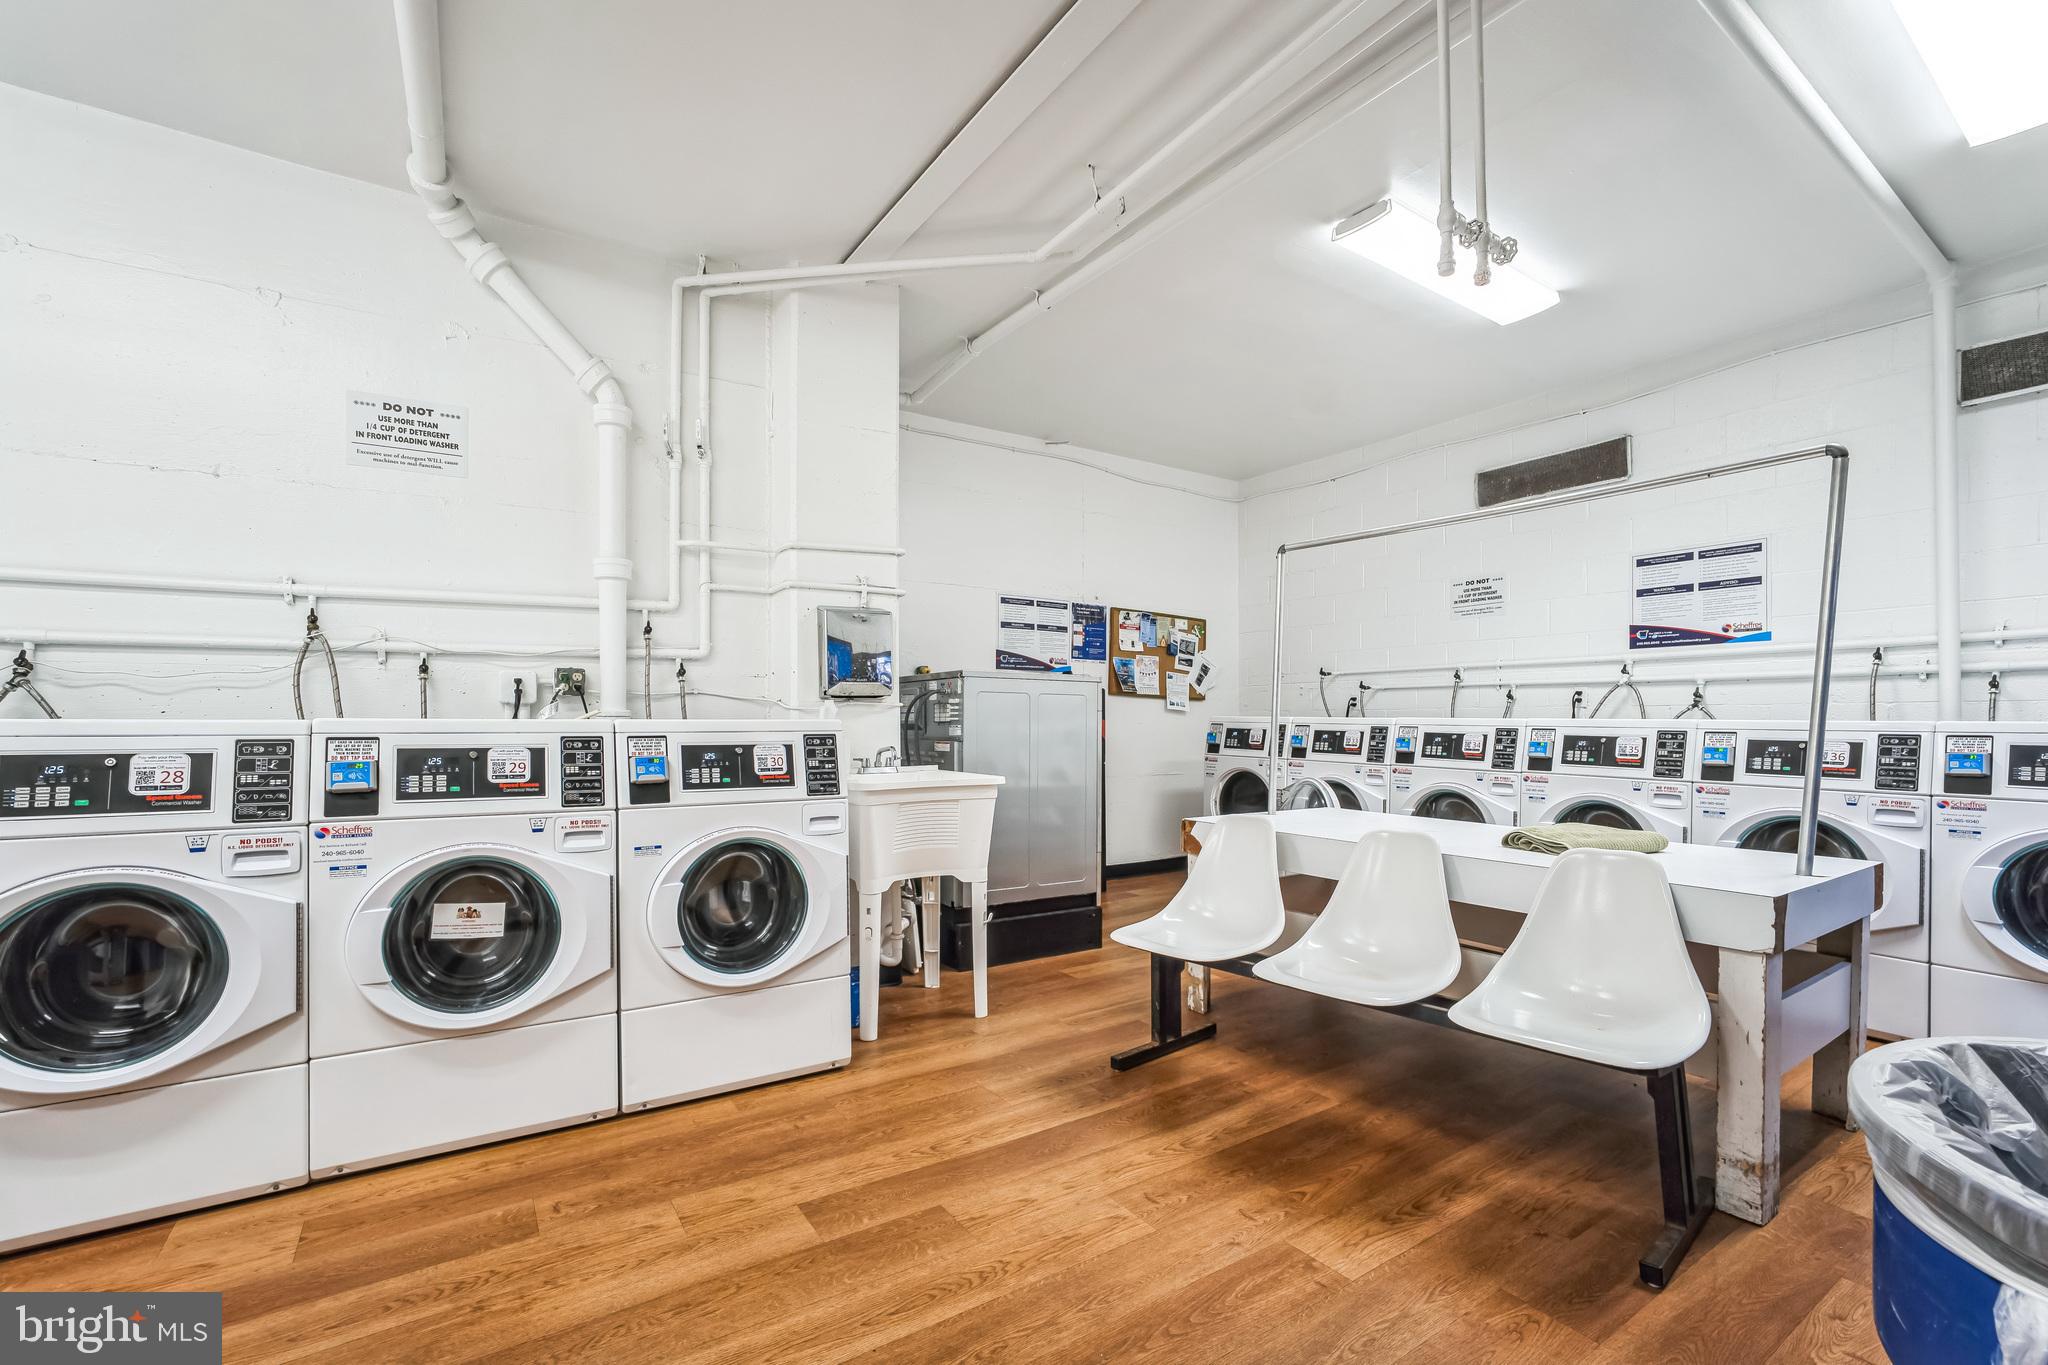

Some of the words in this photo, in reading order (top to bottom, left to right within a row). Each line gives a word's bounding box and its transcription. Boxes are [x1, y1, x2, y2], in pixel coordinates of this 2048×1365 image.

[383, 402, 402, 412] DO
[406, 406, 434, 417] NOT
[378, 415, 392, 423] USE
[394, 417, 415, 426] MORE
[417, 420, 438, 429] THAN
[366, 422, 377, 430] 1/4
[409, 428, 450, 439] DETERGENT
[367, 432, 392, 441] FRONT
[394, 435, 427, 446] LOADING
[429, 440, 459, 450] WASHER
[357, 449, 382, 457] Excessive
[1629, 746, 1640, 754] 35
[1830, 752, 1846, 761] 36
[770, 757, 784, 767] 30
[510, 762, 527, 774] 29
[160, 770, 185, 784] 28
[1950, 800, 1987, 808] Scheffres
[331, 825, 373, 834] Scheffres
[321, 849, 365, 857] 240-965-6040
